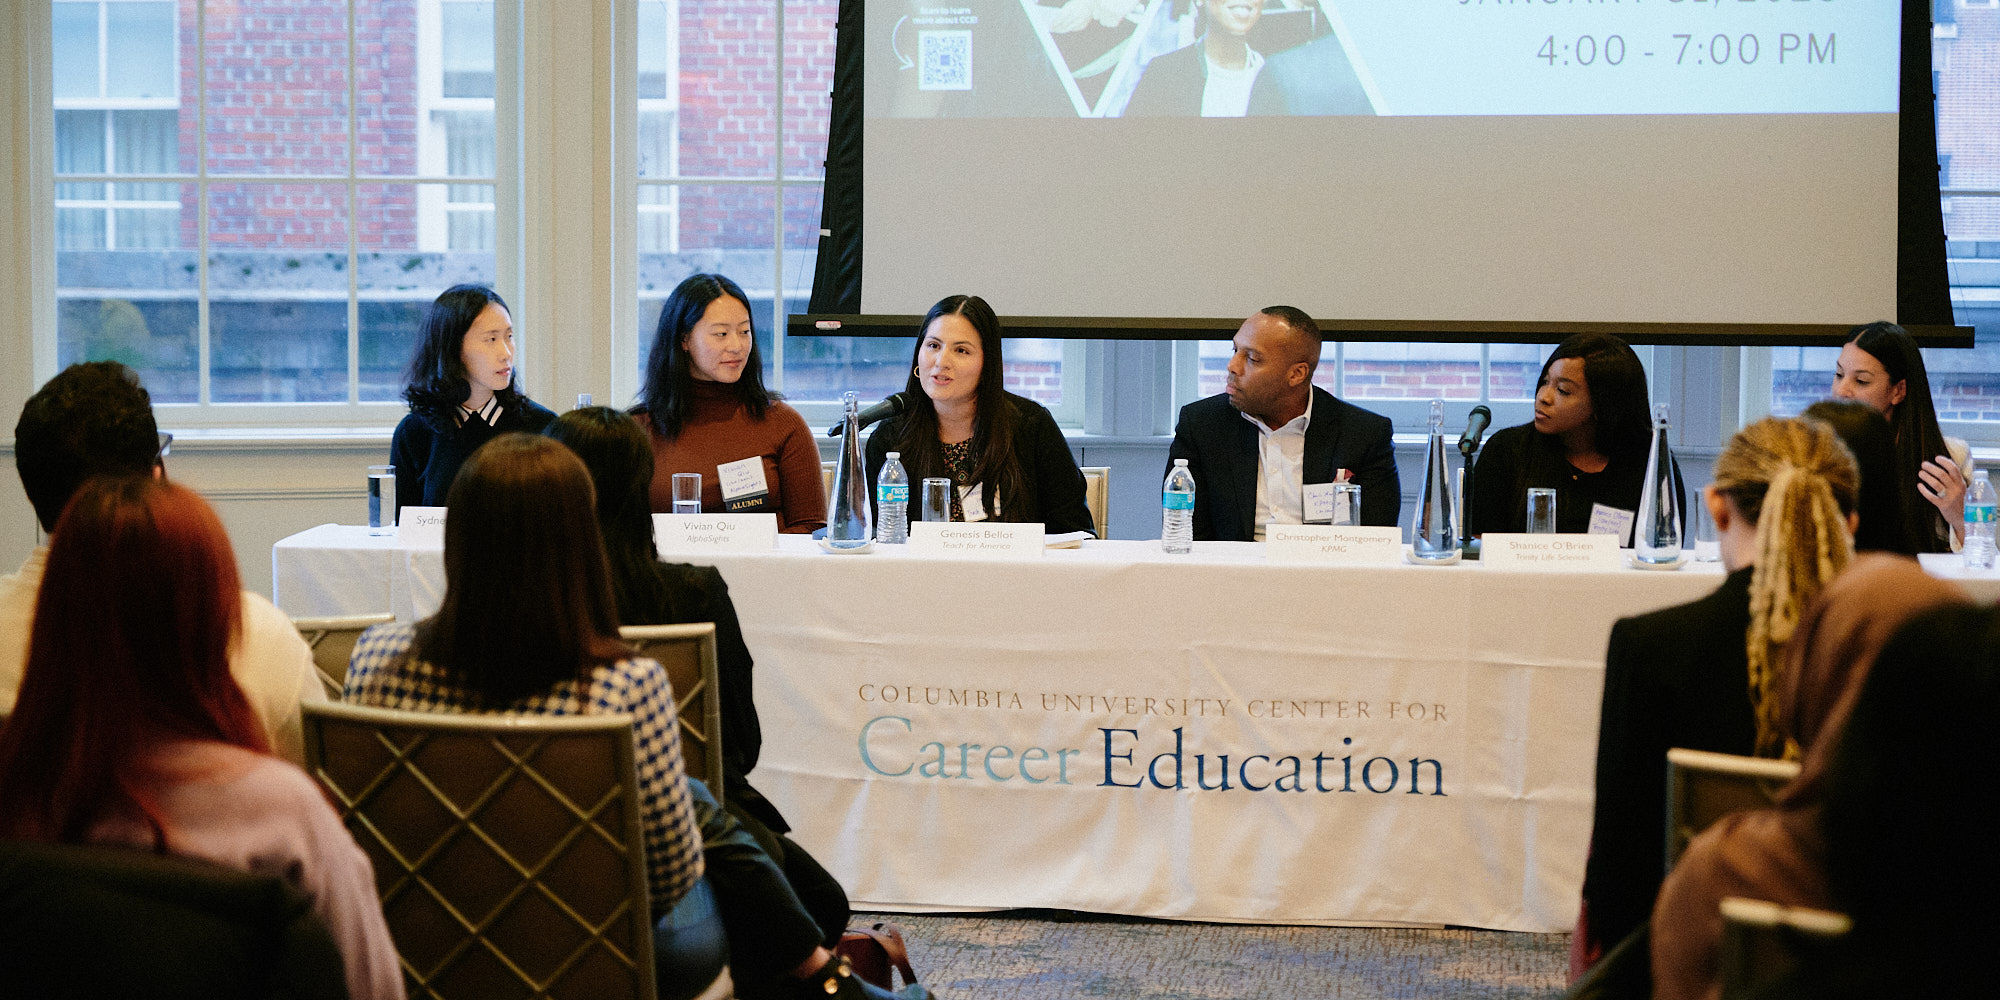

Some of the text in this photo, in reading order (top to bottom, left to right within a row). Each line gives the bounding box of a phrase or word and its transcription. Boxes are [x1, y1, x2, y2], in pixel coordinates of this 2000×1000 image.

[935, 16, 959, 24] about
[1537, 34, 1626, 66] 4:00
[1672, 33, 1760, 66] 7:00
[1779, 32, 1837, 65] PM
[731, 498, 763, 510] ALUMNI
[416, 515, 445, 527] Sydne
[683, 521, 736, 532] Vivian Qiu
[940, 529, 1014, 539] Genesis Bellot
[1276, 532, 1392, 545] Christopher Montgomery
[686, 535, 730, 545] AlphaSights
[942, 541, 1011, 550] Teach for America
[1321, 545, 1347, 553] KPMG
[1509, 541, 1594, 550] Shanice O'Brien
[1516, 553, 1590, 562] Trinity Life Sciences
[858, 684, 1449, 722] COLUMBIA UNIVERSITY CENTER FOR
[858, 715, 1449, 797] Career Education
